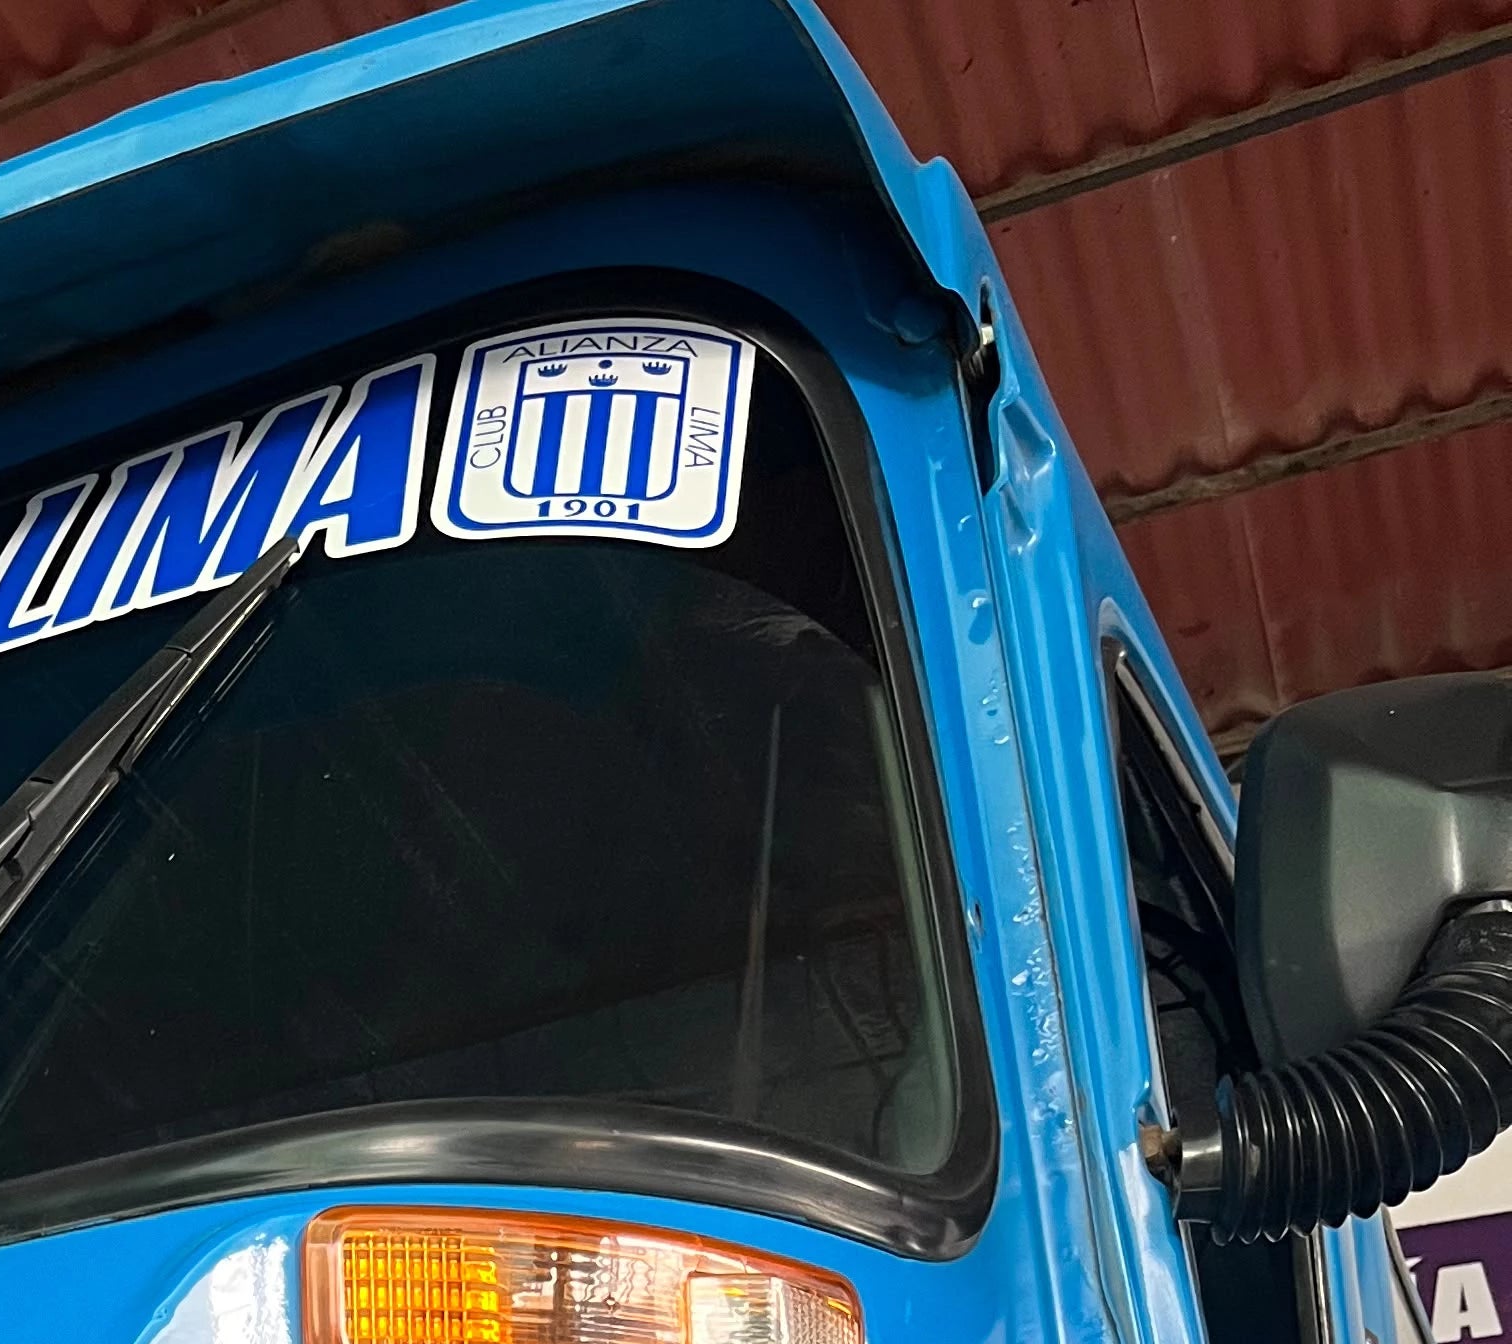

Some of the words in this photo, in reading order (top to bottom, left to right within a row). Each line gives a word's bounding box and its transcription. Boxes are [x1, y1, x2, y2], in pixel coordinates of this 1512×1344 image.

[502, 335, 698, 363] ALIANZA
[469, 405, 507, 469] CLUB
[684, 405, 721, 468] LIMA
[537, 499, 640, 520] 1901
